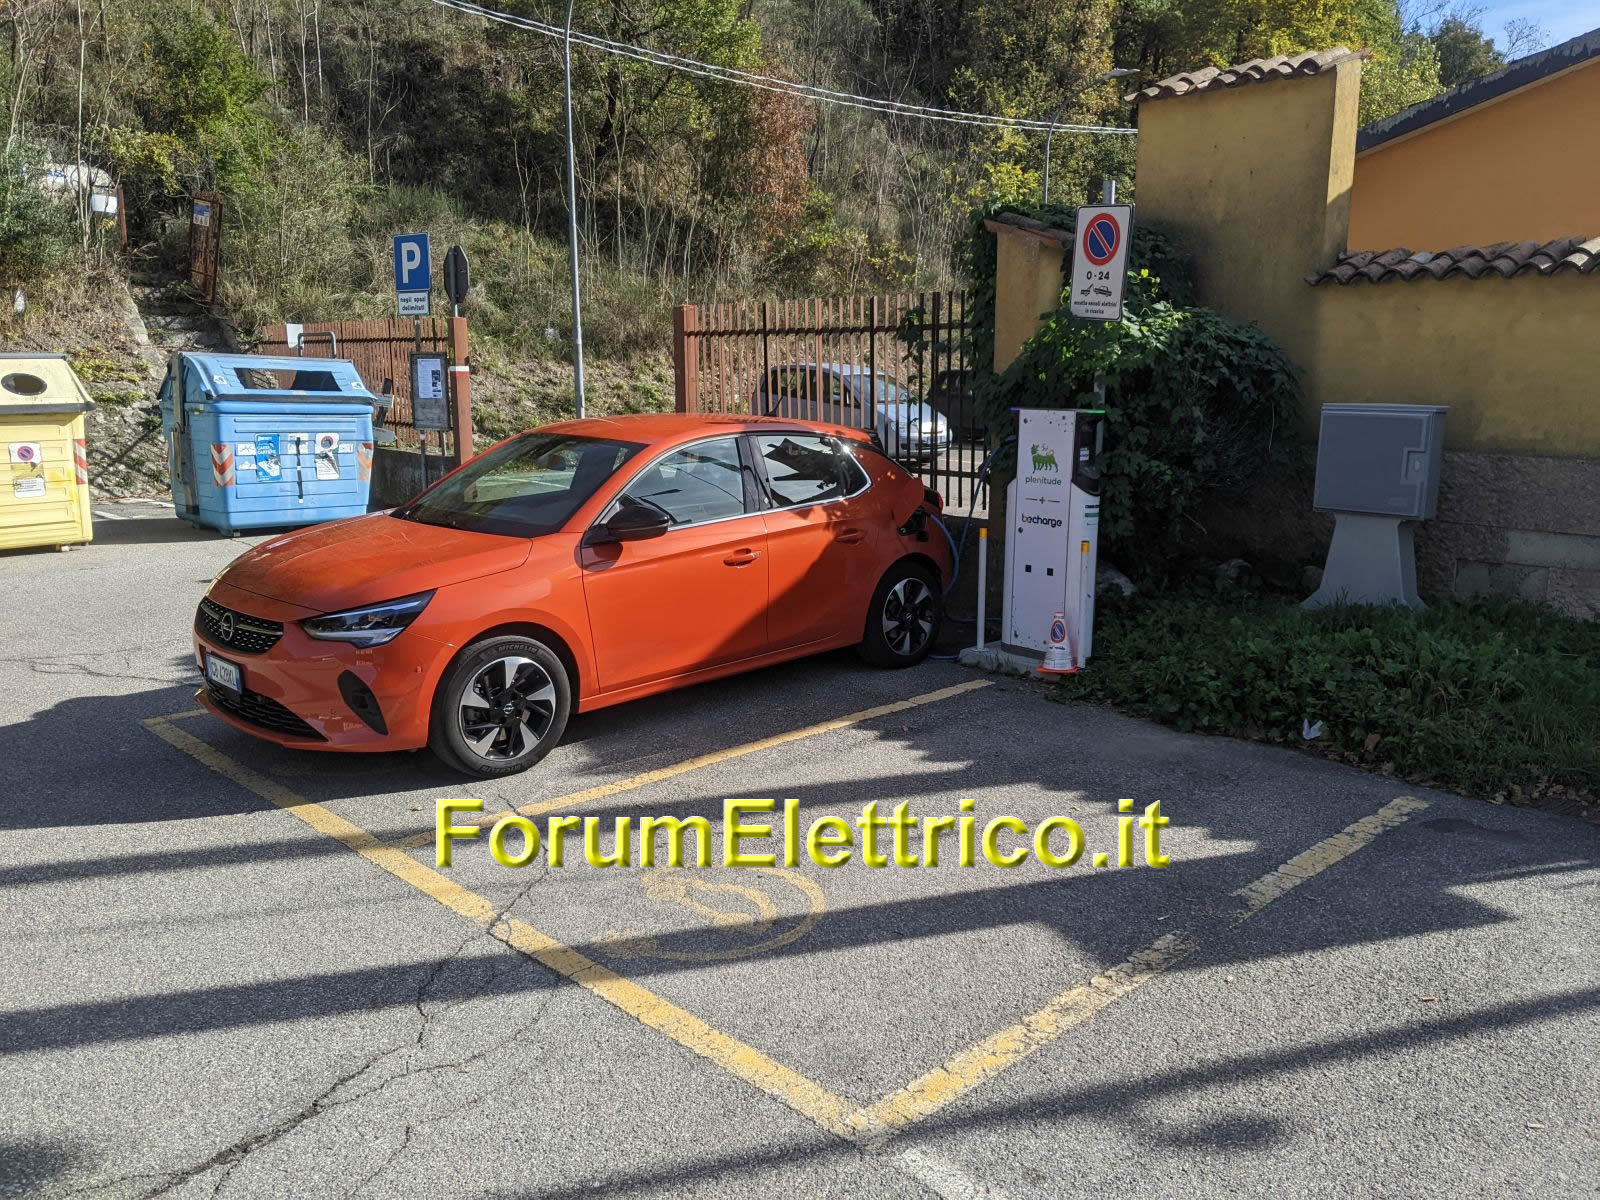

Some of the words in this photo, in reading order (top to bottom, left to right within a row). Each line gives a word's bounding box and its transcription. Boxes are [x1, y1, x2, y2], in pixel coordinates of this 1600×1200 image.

[401, 241, 421, 284] P
[1025, 476, 1062, 486] plenitude
[1021, 513, 1063, 528] becharge
[498, 644, 538, 654] MICHELIN
